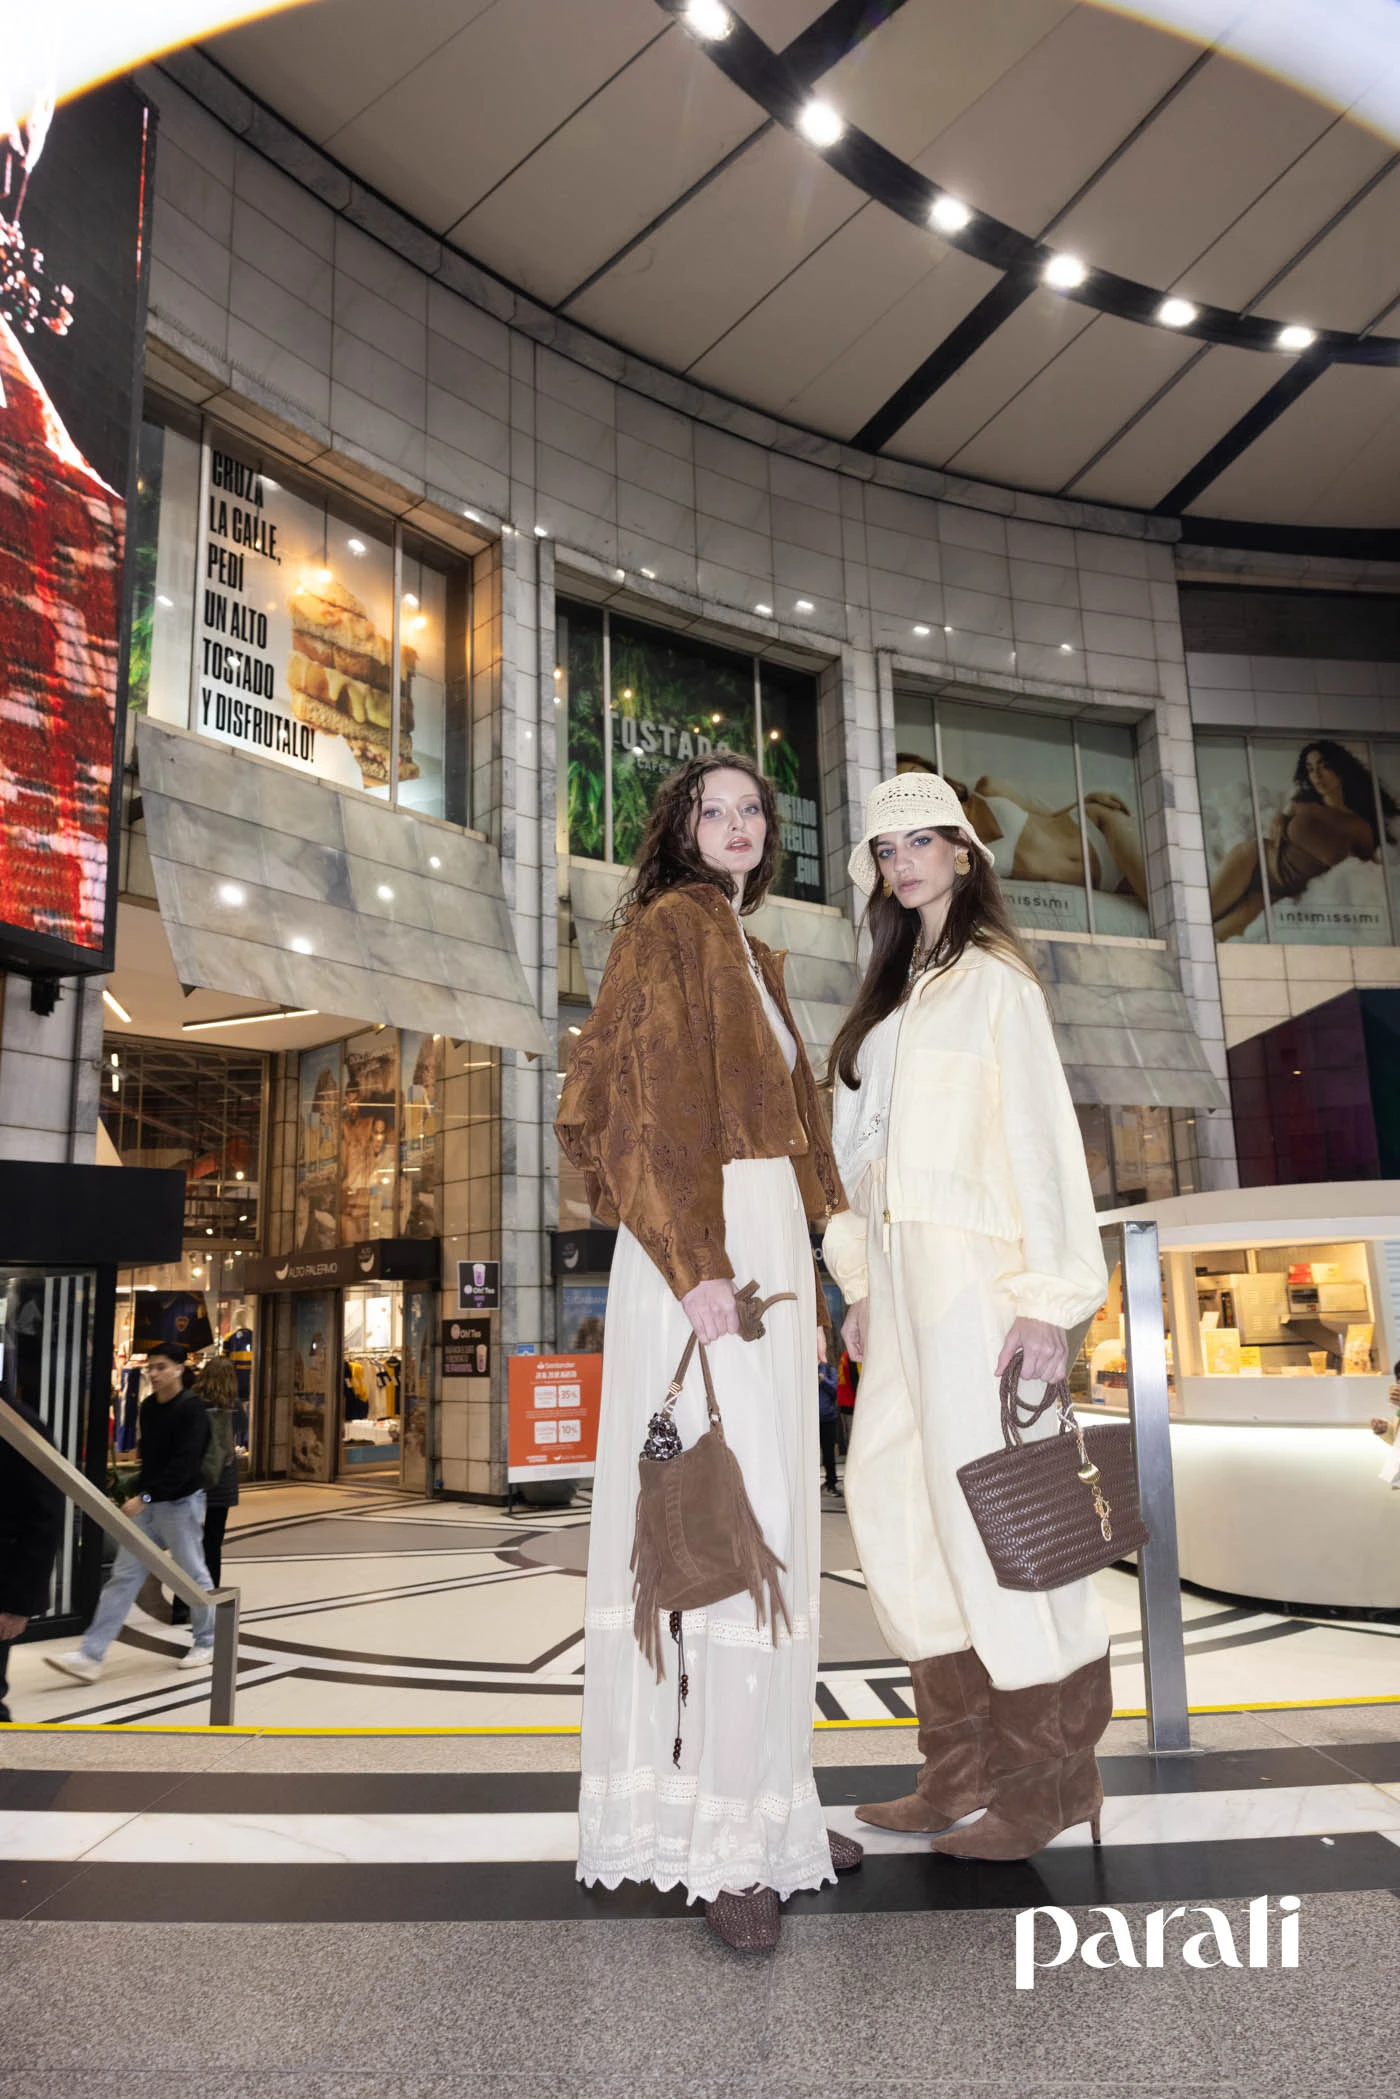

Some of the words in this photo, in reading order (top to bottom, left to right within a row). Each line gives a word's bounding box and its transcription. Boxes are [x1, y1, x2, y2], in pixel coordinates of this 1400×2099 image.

[209, 495, 228, 538] LA
[232, 506, 281, 566] CALLE,
[207, 541, 244, 592] PEDÍ
[204, 589, 227, 633] UN
[230, 601, 268, 649] ALTO
[203, 637, 274, 700] TOSTADO
[202, 687, 212, 726] Y
[215, 693, 316, 763] DISFRUTALO!
[1279, 911, 1380, 924] intimissimi
